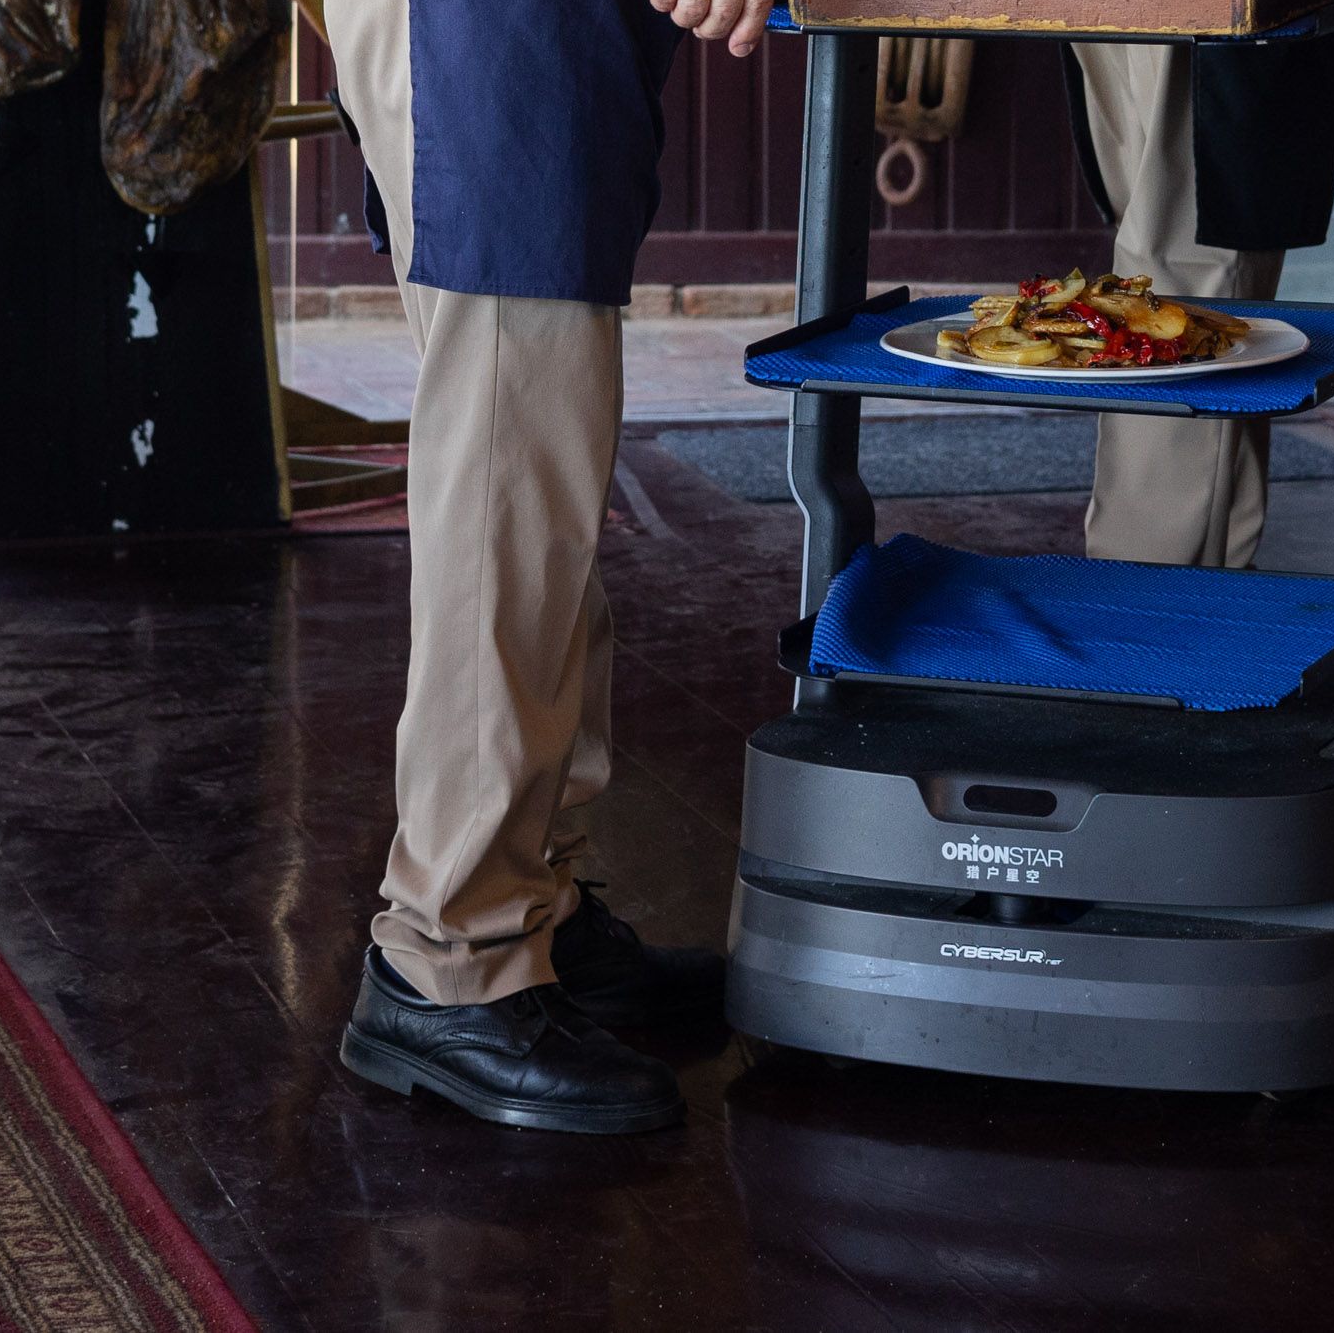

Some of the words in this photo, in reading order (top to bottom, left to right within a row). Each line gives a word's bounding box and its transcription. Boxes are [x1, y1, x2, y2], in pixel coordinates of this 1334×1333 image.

[941, 833, 1064, 868] ORIONSTAR
[966, 865, 1040, 884] 猎户星空
